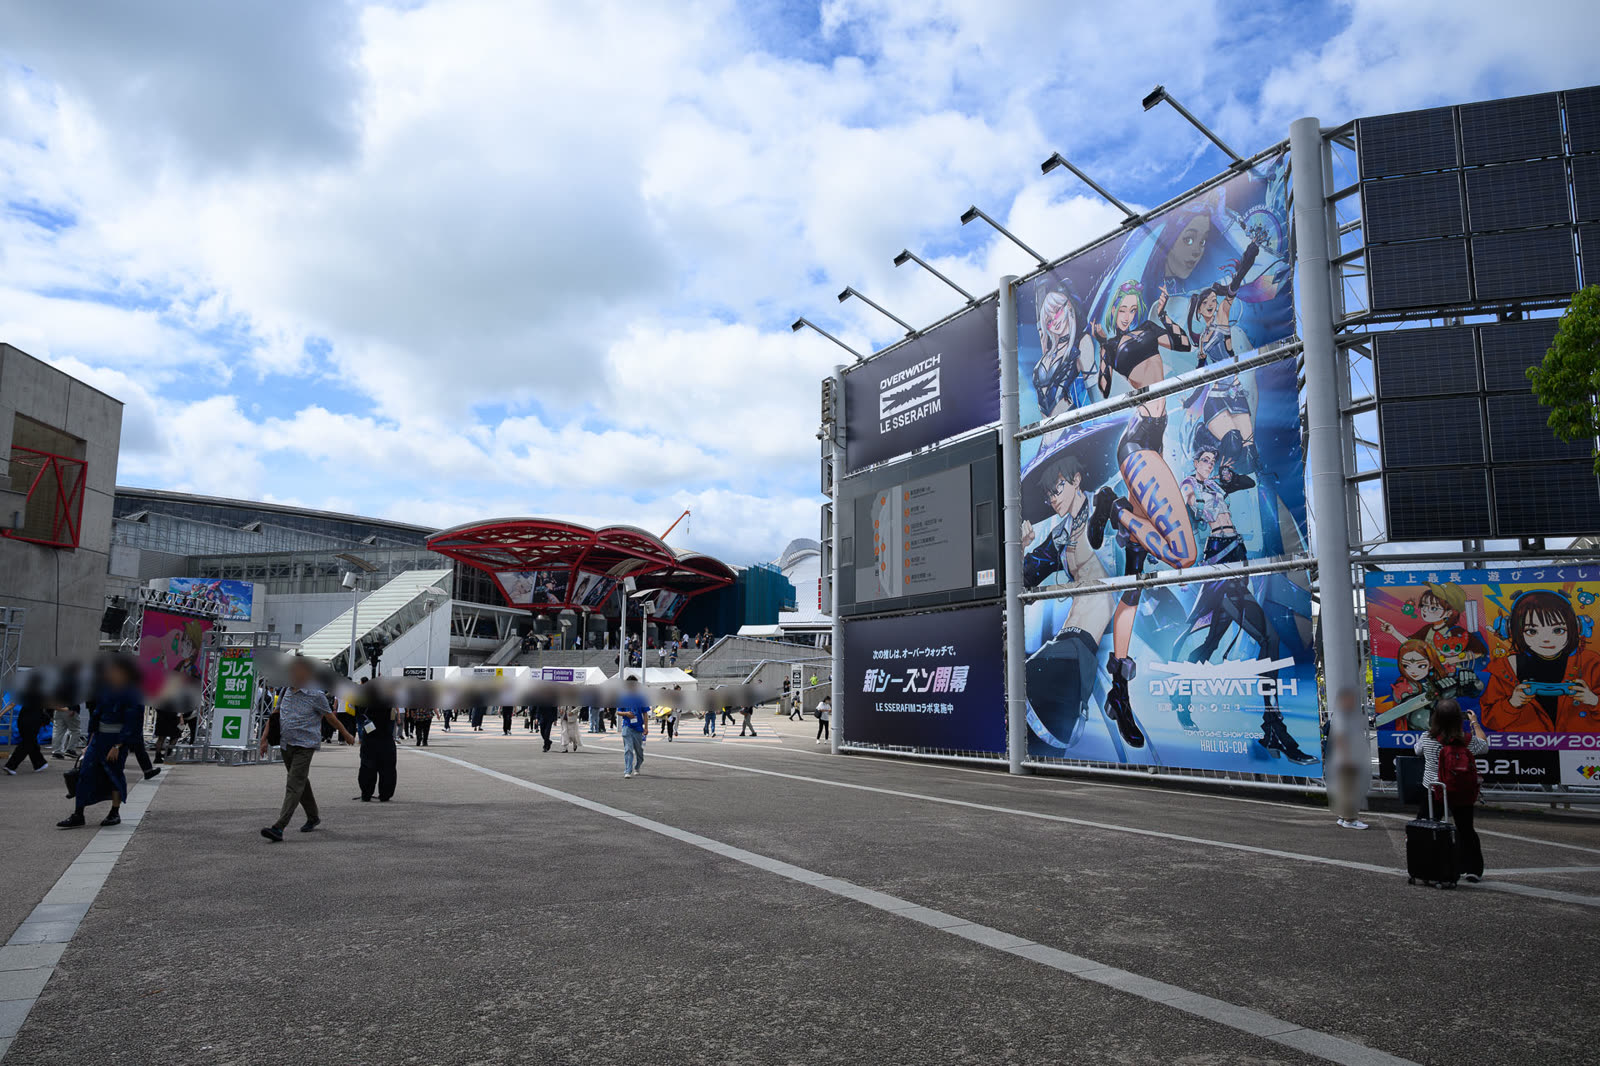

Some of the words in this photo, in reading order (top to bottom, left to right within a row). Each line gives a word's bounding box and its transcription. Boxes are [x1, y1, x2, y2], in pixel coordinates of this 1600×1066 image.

[880, 353, 941, 390] OVERWATCH
[880, 422, 891, 434] LE
[893, 399, 941, 430] SSERAFIM
[1383, 569, 1600, 584] 史上最長、遊びづくし
[222, 661, 253, 676] プレス
[225, 678, 247, 692] 受付
[862, 665, 970, 693] 新シーズン開幕
[1150, 678, 1298, 696] OVERWATCH
[875, 703, 884, 712] LE
[1200, 739, 1218, 753] HALL
[1507, 735, 1566, 747] SHOW
